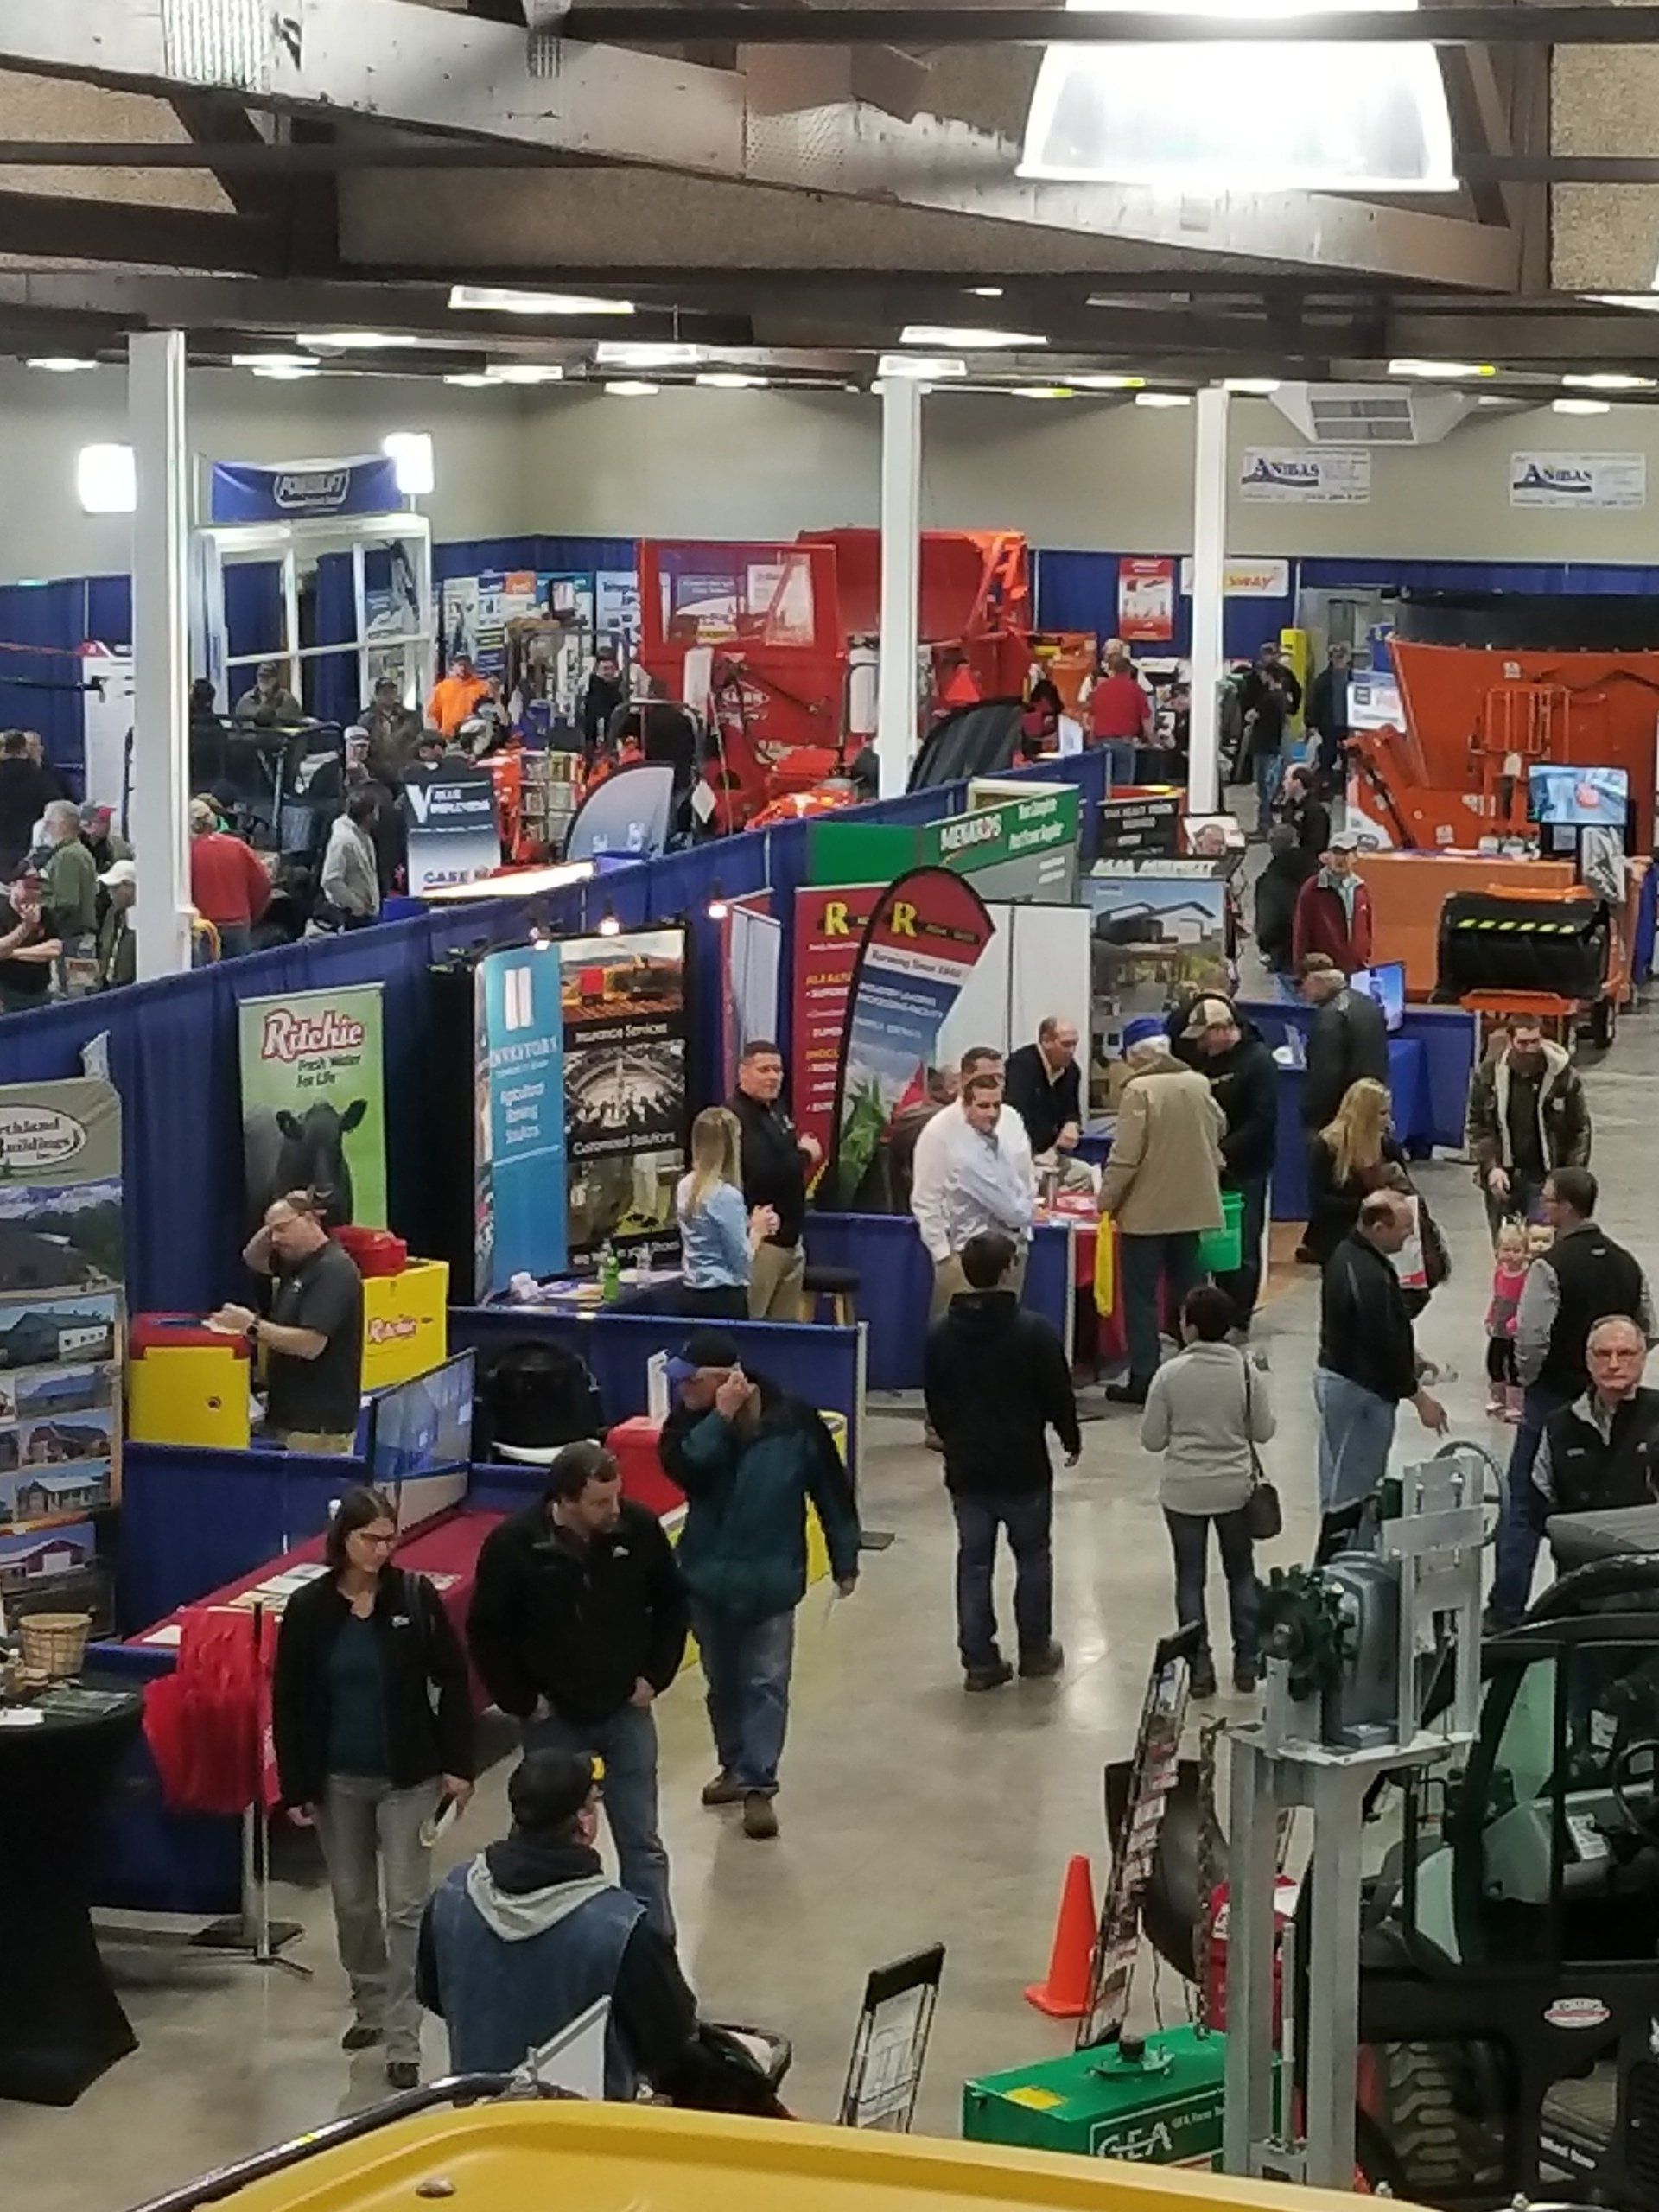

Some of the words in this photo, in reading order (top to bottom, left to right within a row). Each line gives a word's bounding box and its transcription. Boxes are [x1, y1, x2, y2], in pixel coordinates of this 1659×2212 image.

[262, 1008, 365, 1064] Ritchie
[297, 1074, 315, 1088] For
[1096, 2121, 1173, 2160] GEA
